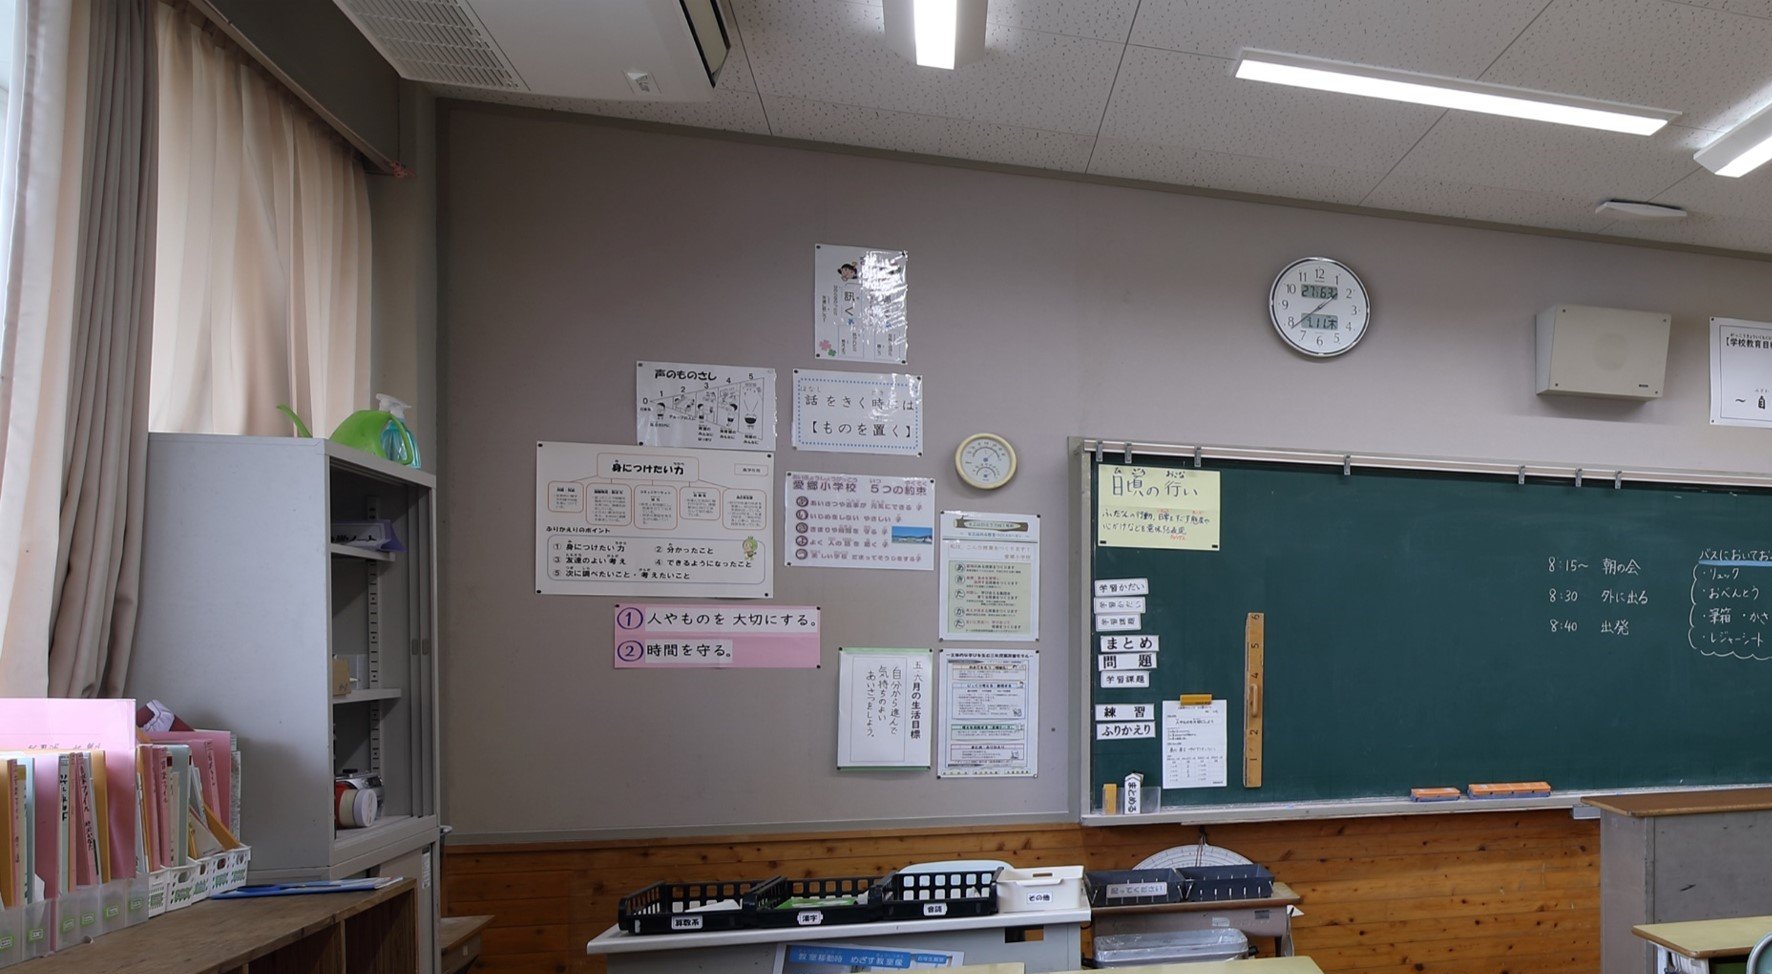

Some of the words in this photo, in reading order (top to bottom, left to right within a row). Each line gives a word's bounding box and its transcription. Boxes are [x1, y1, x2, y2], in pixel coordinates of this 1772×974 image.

[1299, 272, 1307, 282] 11
[1315, 269, 1324, 279] 12
[1286, 283, 1296, 294] 10
[1346, 288, 1352, 299] 2
[1282, 300, 1289, 309] 9
[1352, 306, 1357, 316] 3
[1288, 317, 1295, 327] 8
[1346, 322, 1352, 331] 4
[1301, 330, 1307, 341] 7
[1317, 336, 1323, 346] 6
[1334, 333, 1340, 343] 5
[655, 369, 717, 381] 声のものさし
[812, 421, 911, 438] 【ものを置く】
[612, 462, 685, 476] 身につけたい力
[793, 480, 857, 493] 愛郷小学校
[1112, 474, 1199, 498] 日頃の行い
[566, 544, 626, 553] 身につけたい力
[667, 546, 715, 555] 分かったこと
[566, 556, 627, 566] 友達のよい考え
[667, 559, 753, 569] できるようになったこと
[1602, 557, 1641, 577] 朝の会
[1098, 583, 1145, 593] 学習かだい
[1708, 585, 1760, 600] おべんとう
[1549, 588, 1578, 602] 8:30
[1600, 588, 1649, 606] 外に出る
[1099, 600, 1142, 609] 学習かだい
[646, 612, 725, 626] 人やものを
[733, 612, 816, 627] 大切にする。
[1101, 616, 1135, 626] 学習課題
[1708, 607, 1732, 625] 筆箱
[1749, 610, 1769, 625] かさ
[1549, 619, 1578, 633] 8:40
[1600, 618, 1629, 636] 出発
[1709, 629, 1764, 647] レジャーシート
[1107, 637, 1152, 651] まとめ
[646, 644, 731, 658] 時間を守る。
[1103, 654, 1153, 669] 問題
[1105, 674, 1145, 684] 学習課題
[878, 664, 889, 721] 気持ちのよい
[889, 666, 902, 735] 自分から進んで
[1103, 706, 1146, 719] 練習
[1101, 724, 1151, 738] ふりかえり
[1029, 894, 1051, 902] その他
